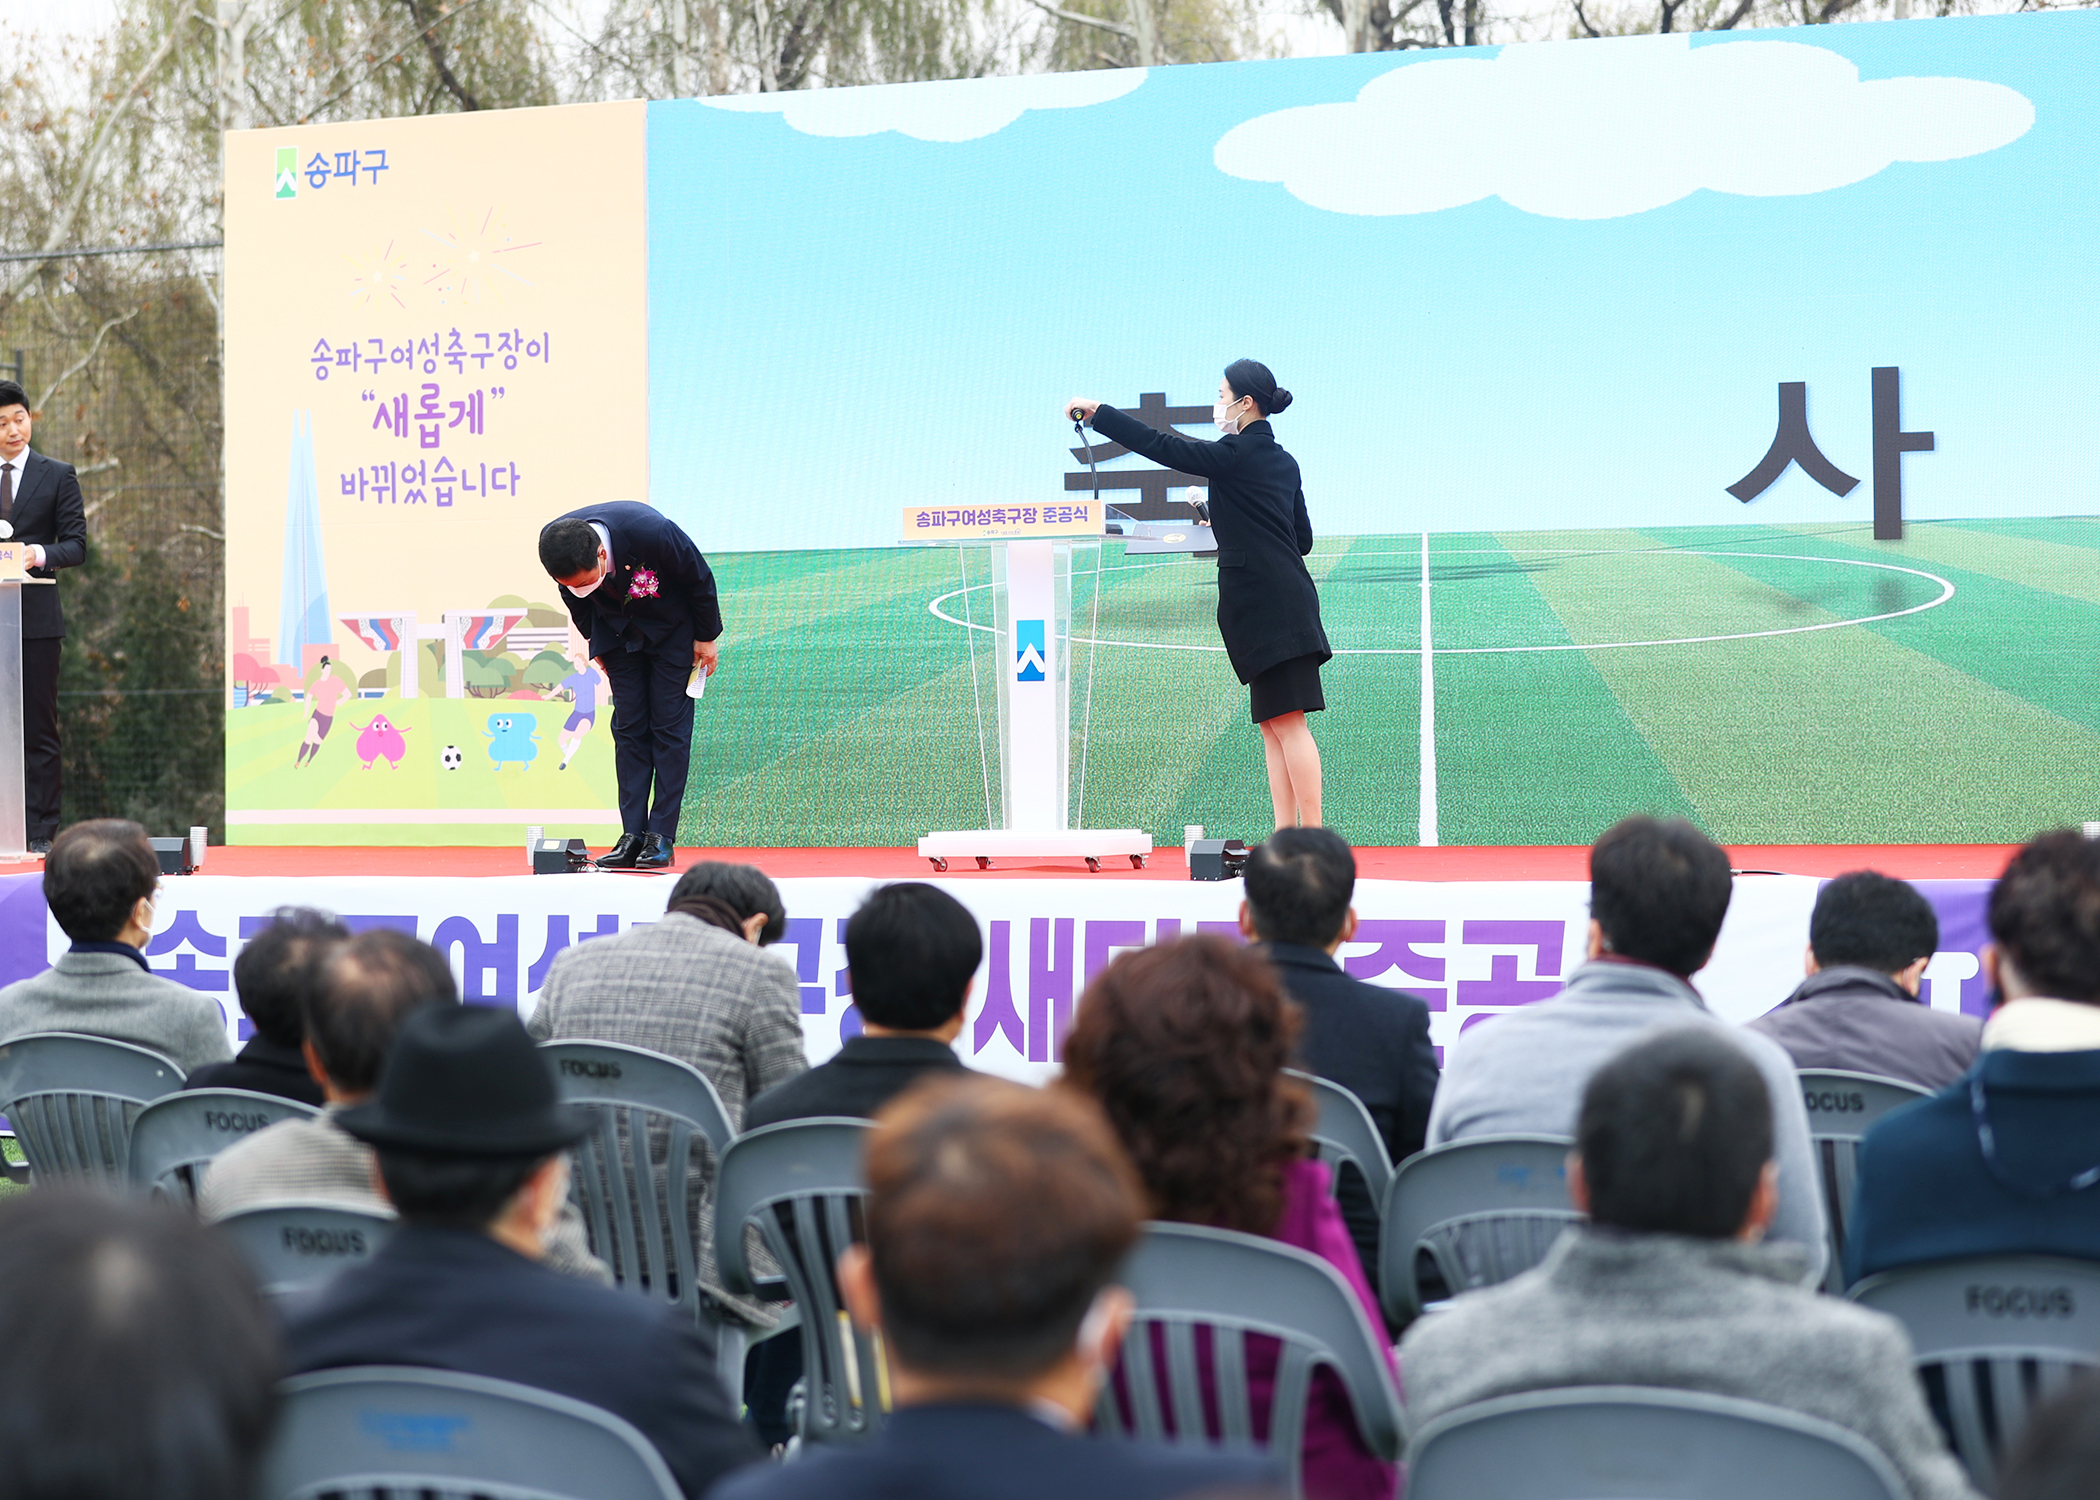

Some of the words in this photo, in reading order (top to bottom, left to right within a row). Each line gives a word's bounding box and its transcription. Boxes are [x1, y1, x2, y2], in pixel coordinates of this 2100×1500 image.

[304, 149, 390, 189] 송파구
[310, 327, 550, 381] 송파구여성축구장이
[1064, 392, 1218, 557] 축
[1724, 366, 1935, 540] 사
[340, 456, 520, 507] 바뀌었습니다
[916, 507, 1038, 529] 송파구여성축구장
[1042, 505, 1089, 524] 준공식
[559, 1059, 623, 1079] FOCUS
[1804, 1091, 1865, 1113] OCUS
[205, 1110, 271, 1132] FOCUS
[281, 1226, 368, 1256] FOCUS
[1964, 1284, 2077, 1320] FOCUS
